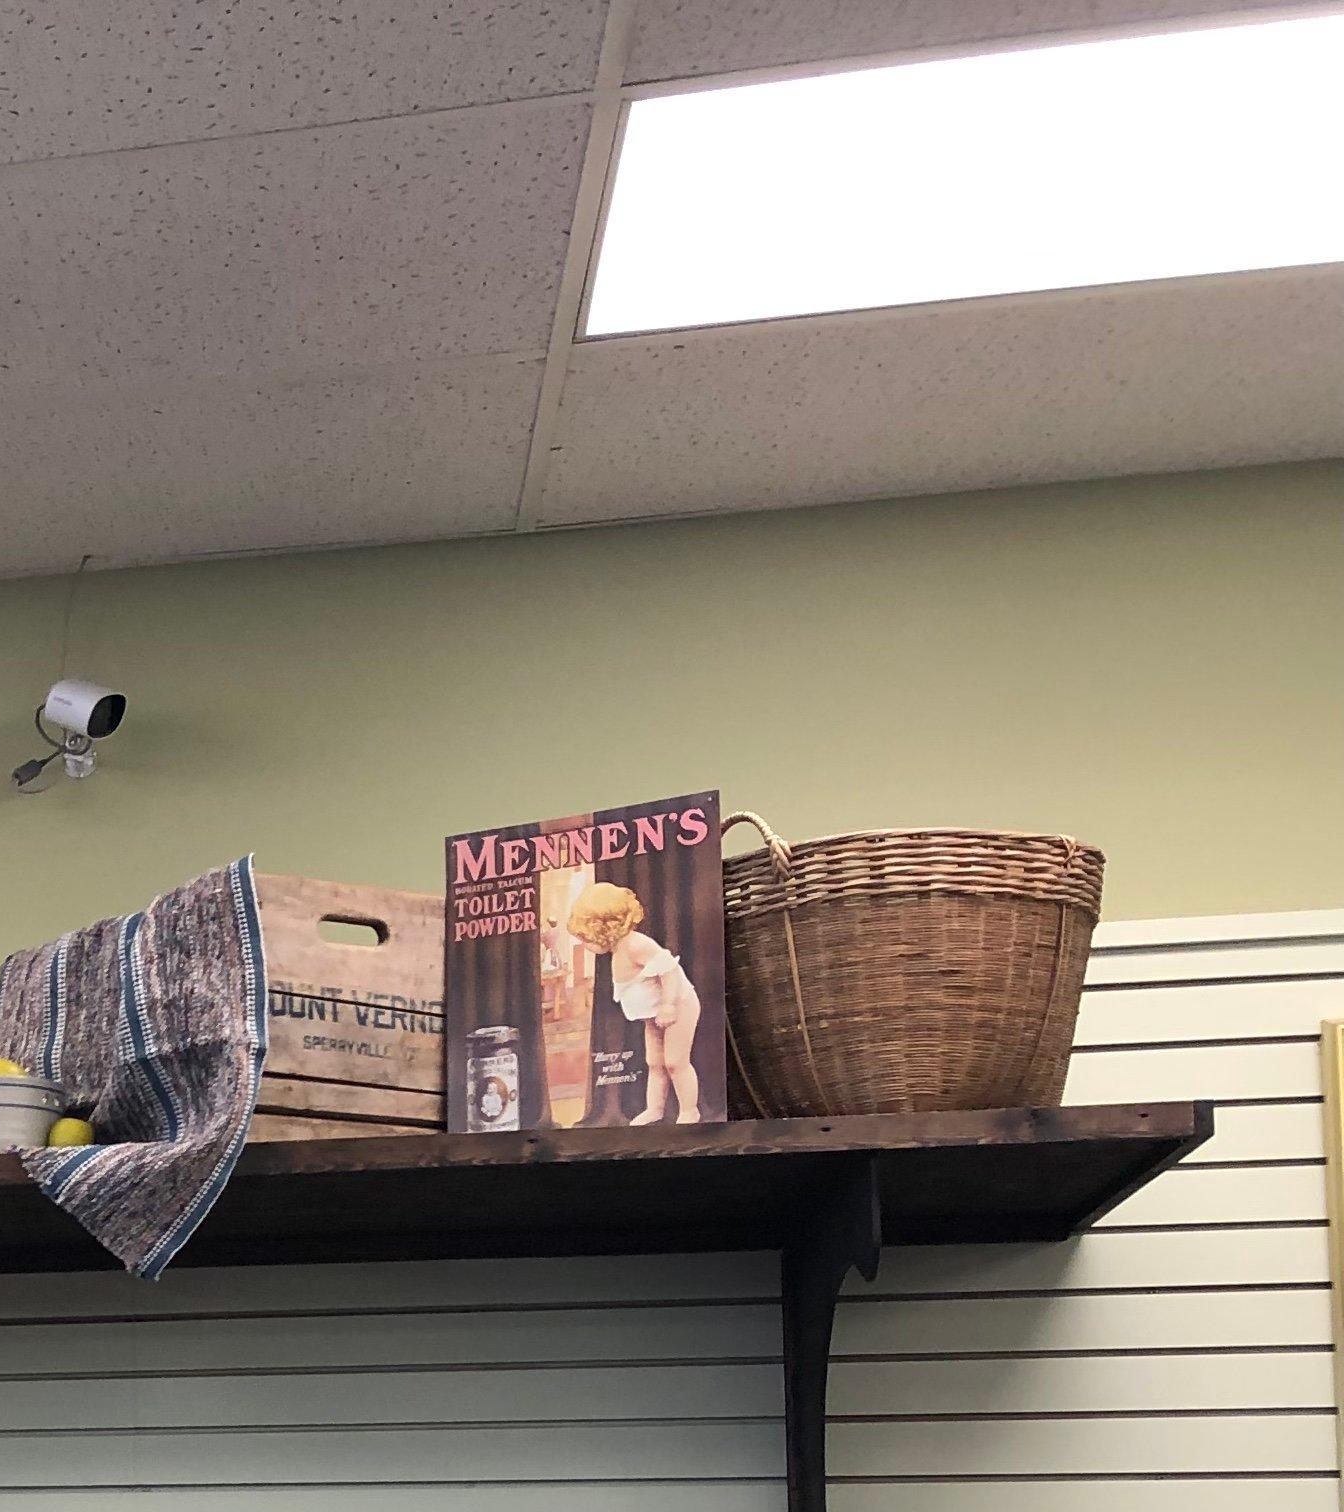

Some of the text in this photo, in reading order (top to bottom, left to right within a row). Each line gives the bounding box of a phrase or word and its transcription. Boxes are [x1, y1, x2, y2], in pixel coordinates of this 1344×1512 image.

[452, 807, 709, 884] MENNEN'S
[454, 888, 536, 918] TOILET
[454, 912, 537, 942] POWDER
